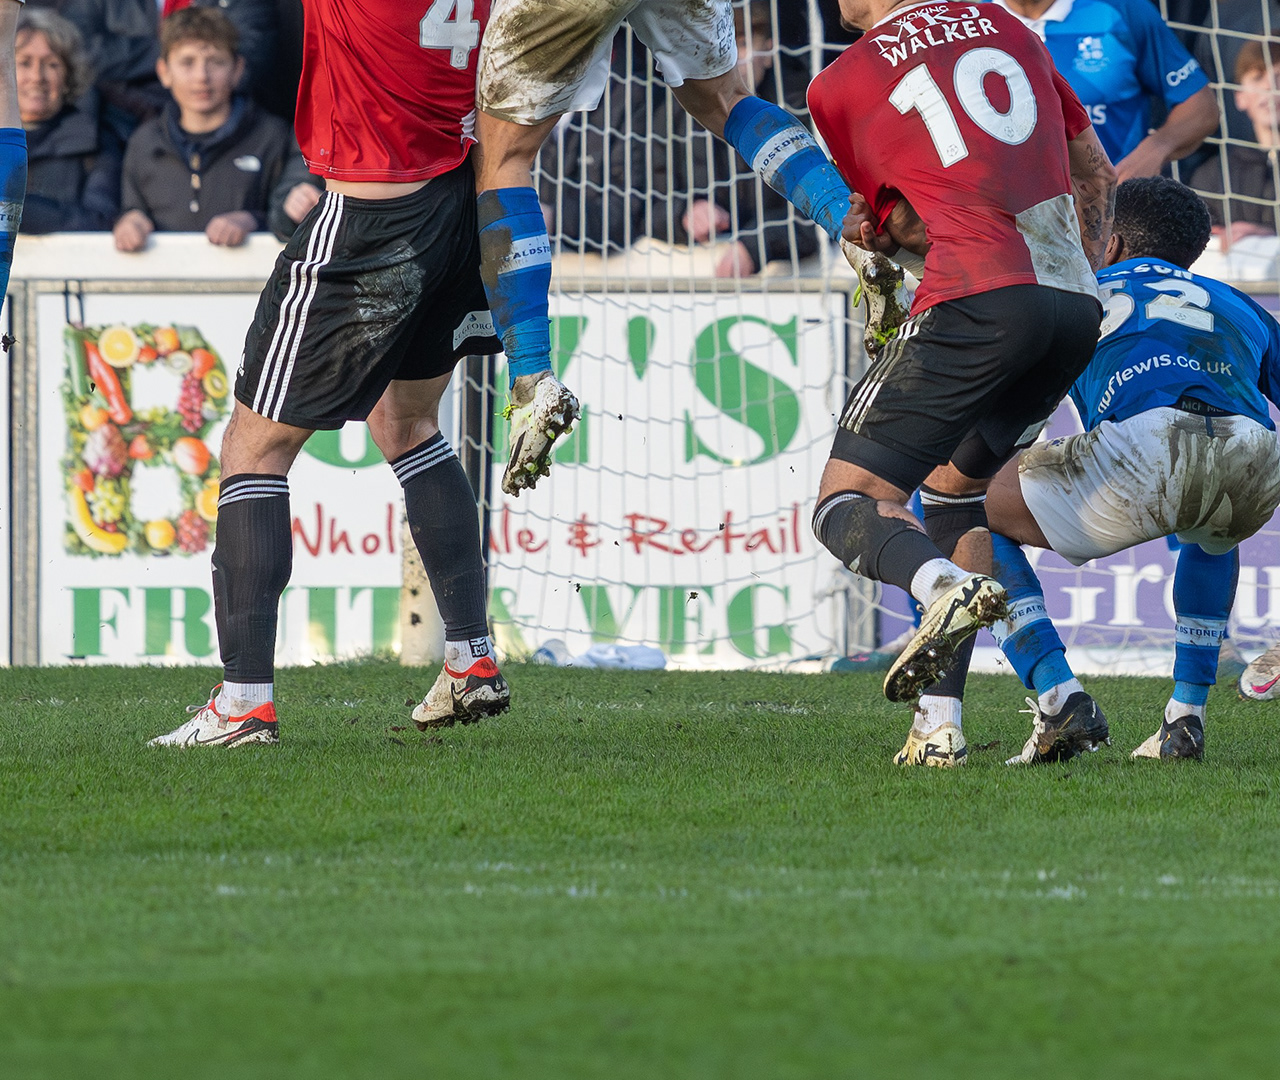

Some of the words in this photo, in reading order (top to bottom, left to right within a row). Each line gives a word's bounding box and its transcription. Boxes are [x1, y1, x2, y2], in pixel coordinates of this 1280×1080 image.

[882, 18, 999, 67] WALKER
[891, 4, 949, 26] WOKING
[888, 46, 1038, 169] 10
[569, 512, 603, 558] &
[623, 502, 803, 558] Retail
[578, 582, 798, 660] VEG
